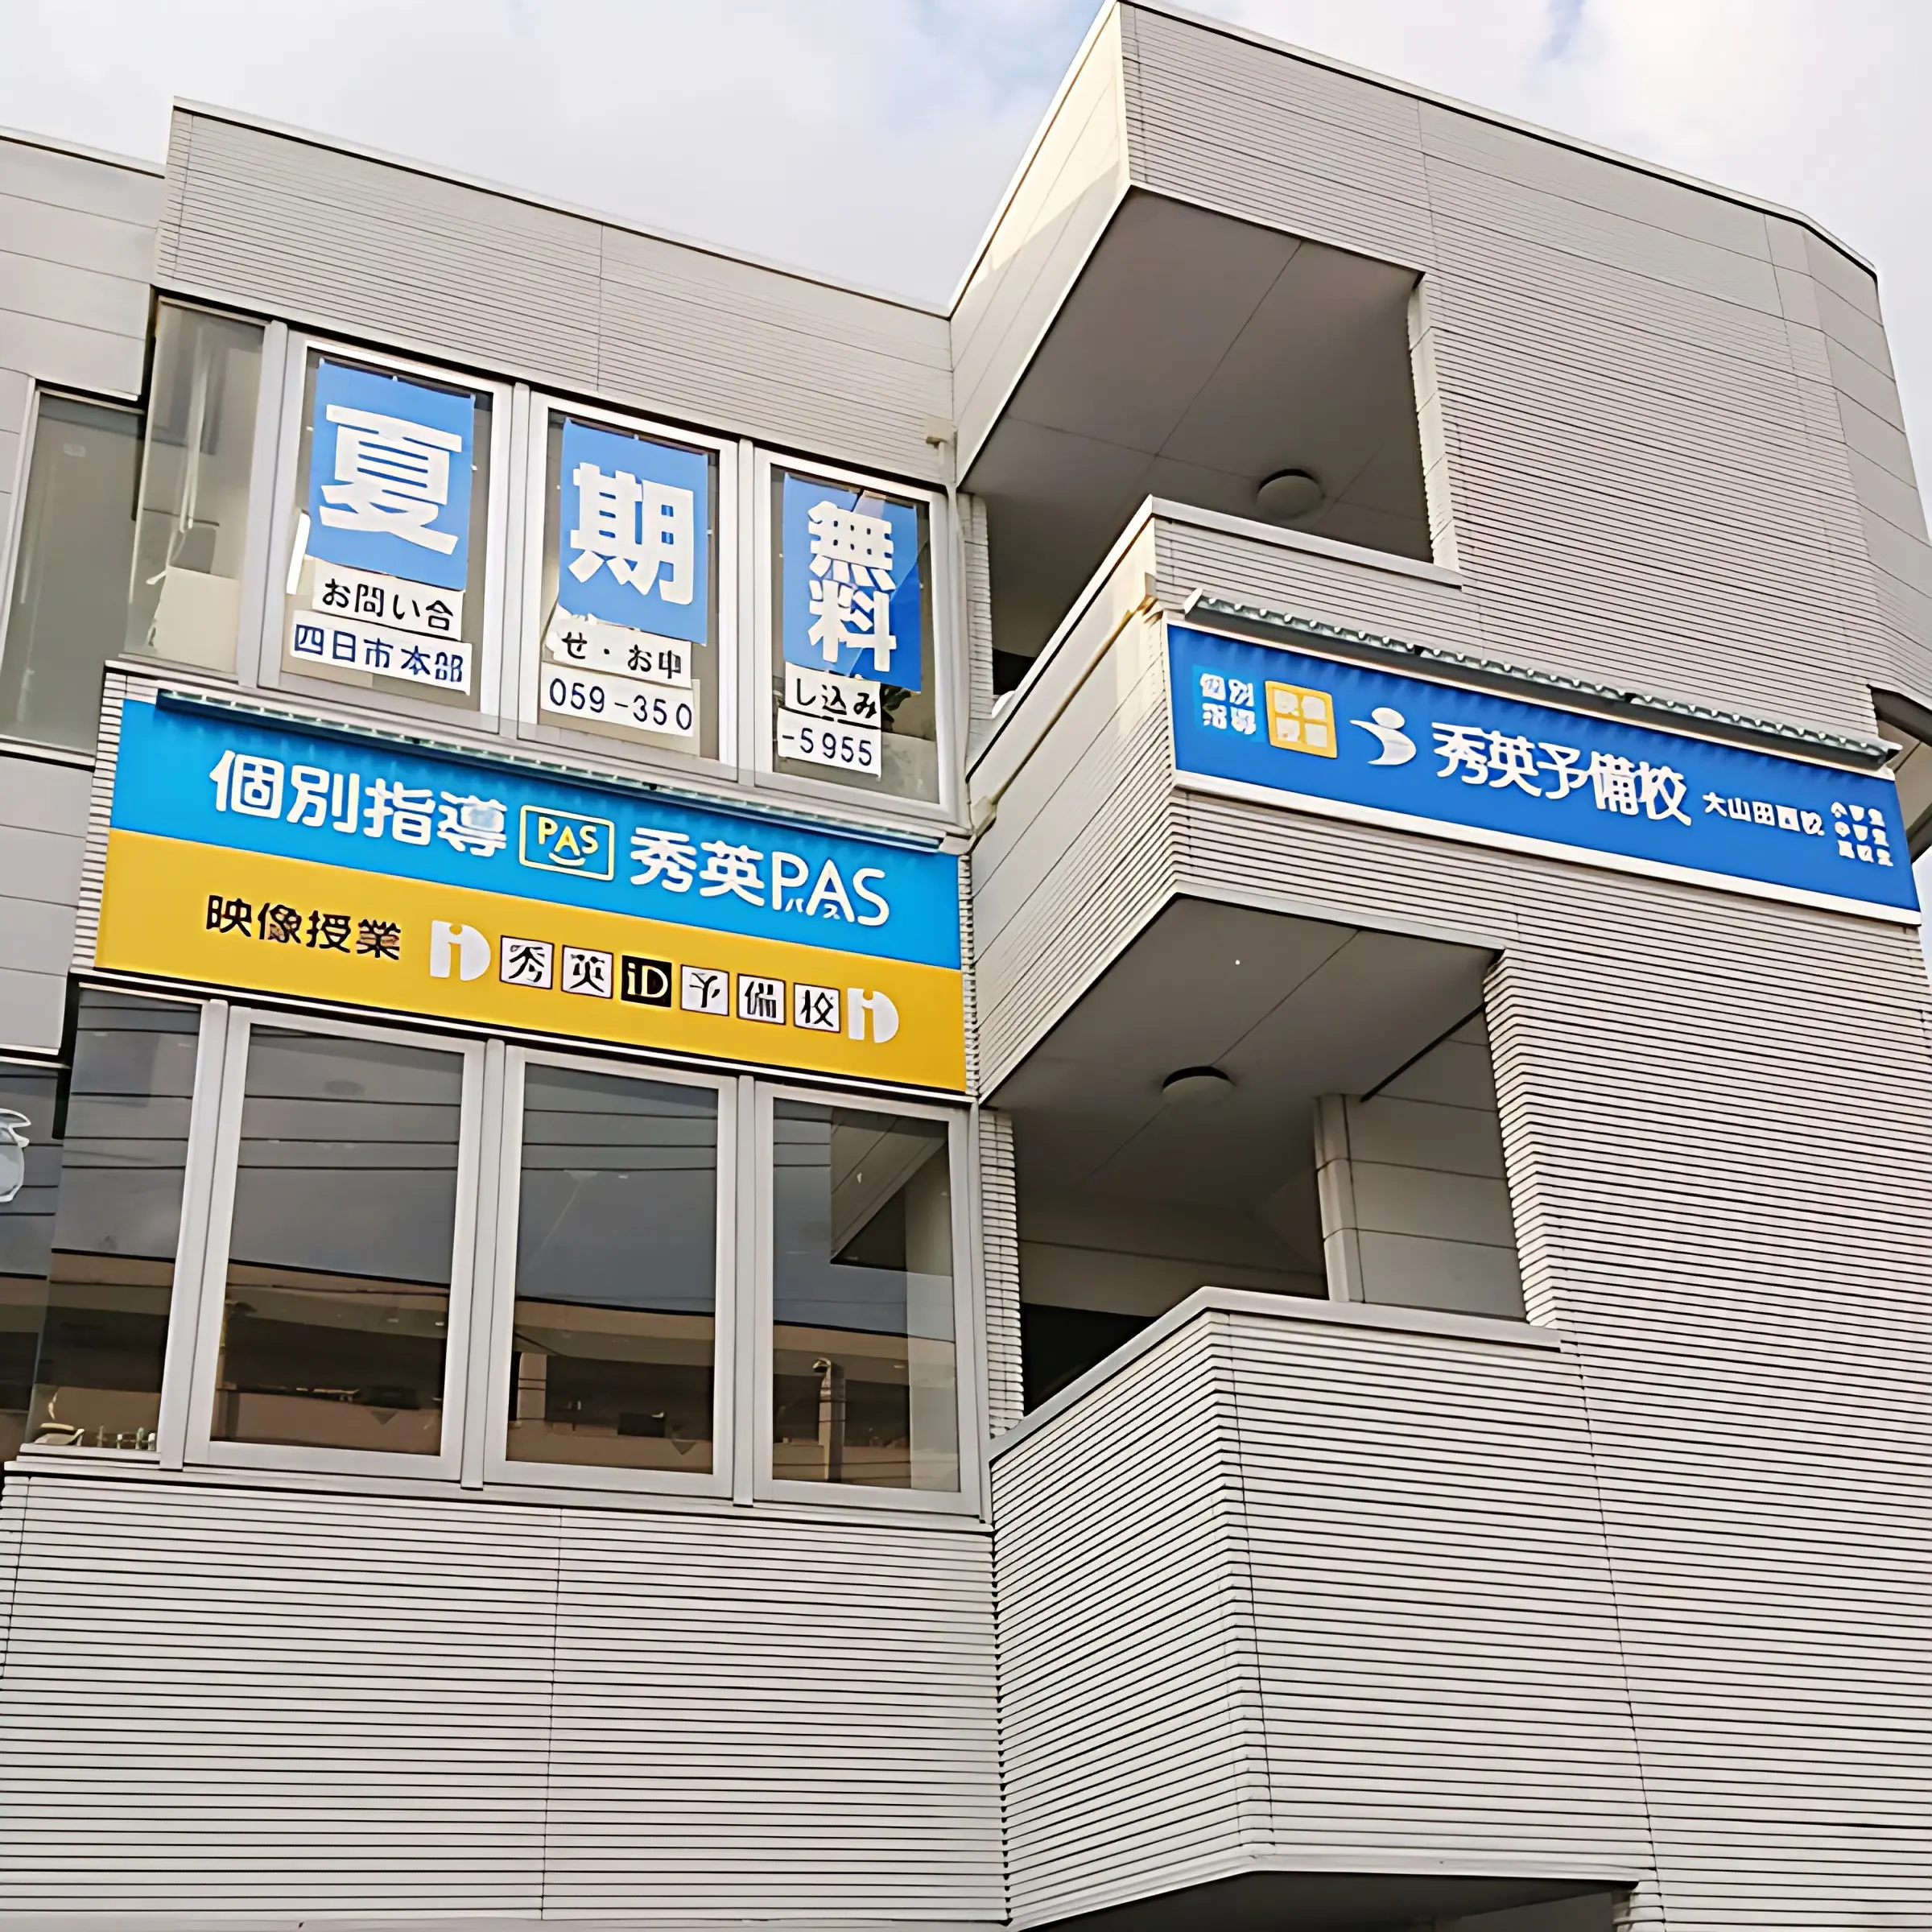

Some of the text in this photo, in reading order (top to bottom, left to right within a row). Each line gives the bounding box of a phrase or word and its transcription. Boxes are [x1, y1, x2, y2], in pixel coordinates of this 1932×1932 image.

[319, 404, 897, 672] 夏 期 無料
[294, 623, 464, 683] 四日市本部
[549, 678, 692, 730] 059-350
[322, 577, 453, 631] お問い合
[795, 677, 878, 719] し込み
[1430, 721, 1692, 826] 秀英予備校
[209, 749, 890, 927] 個別指導 PAS 秀英PAS
[206, 894, 402, 960] 映像授業
